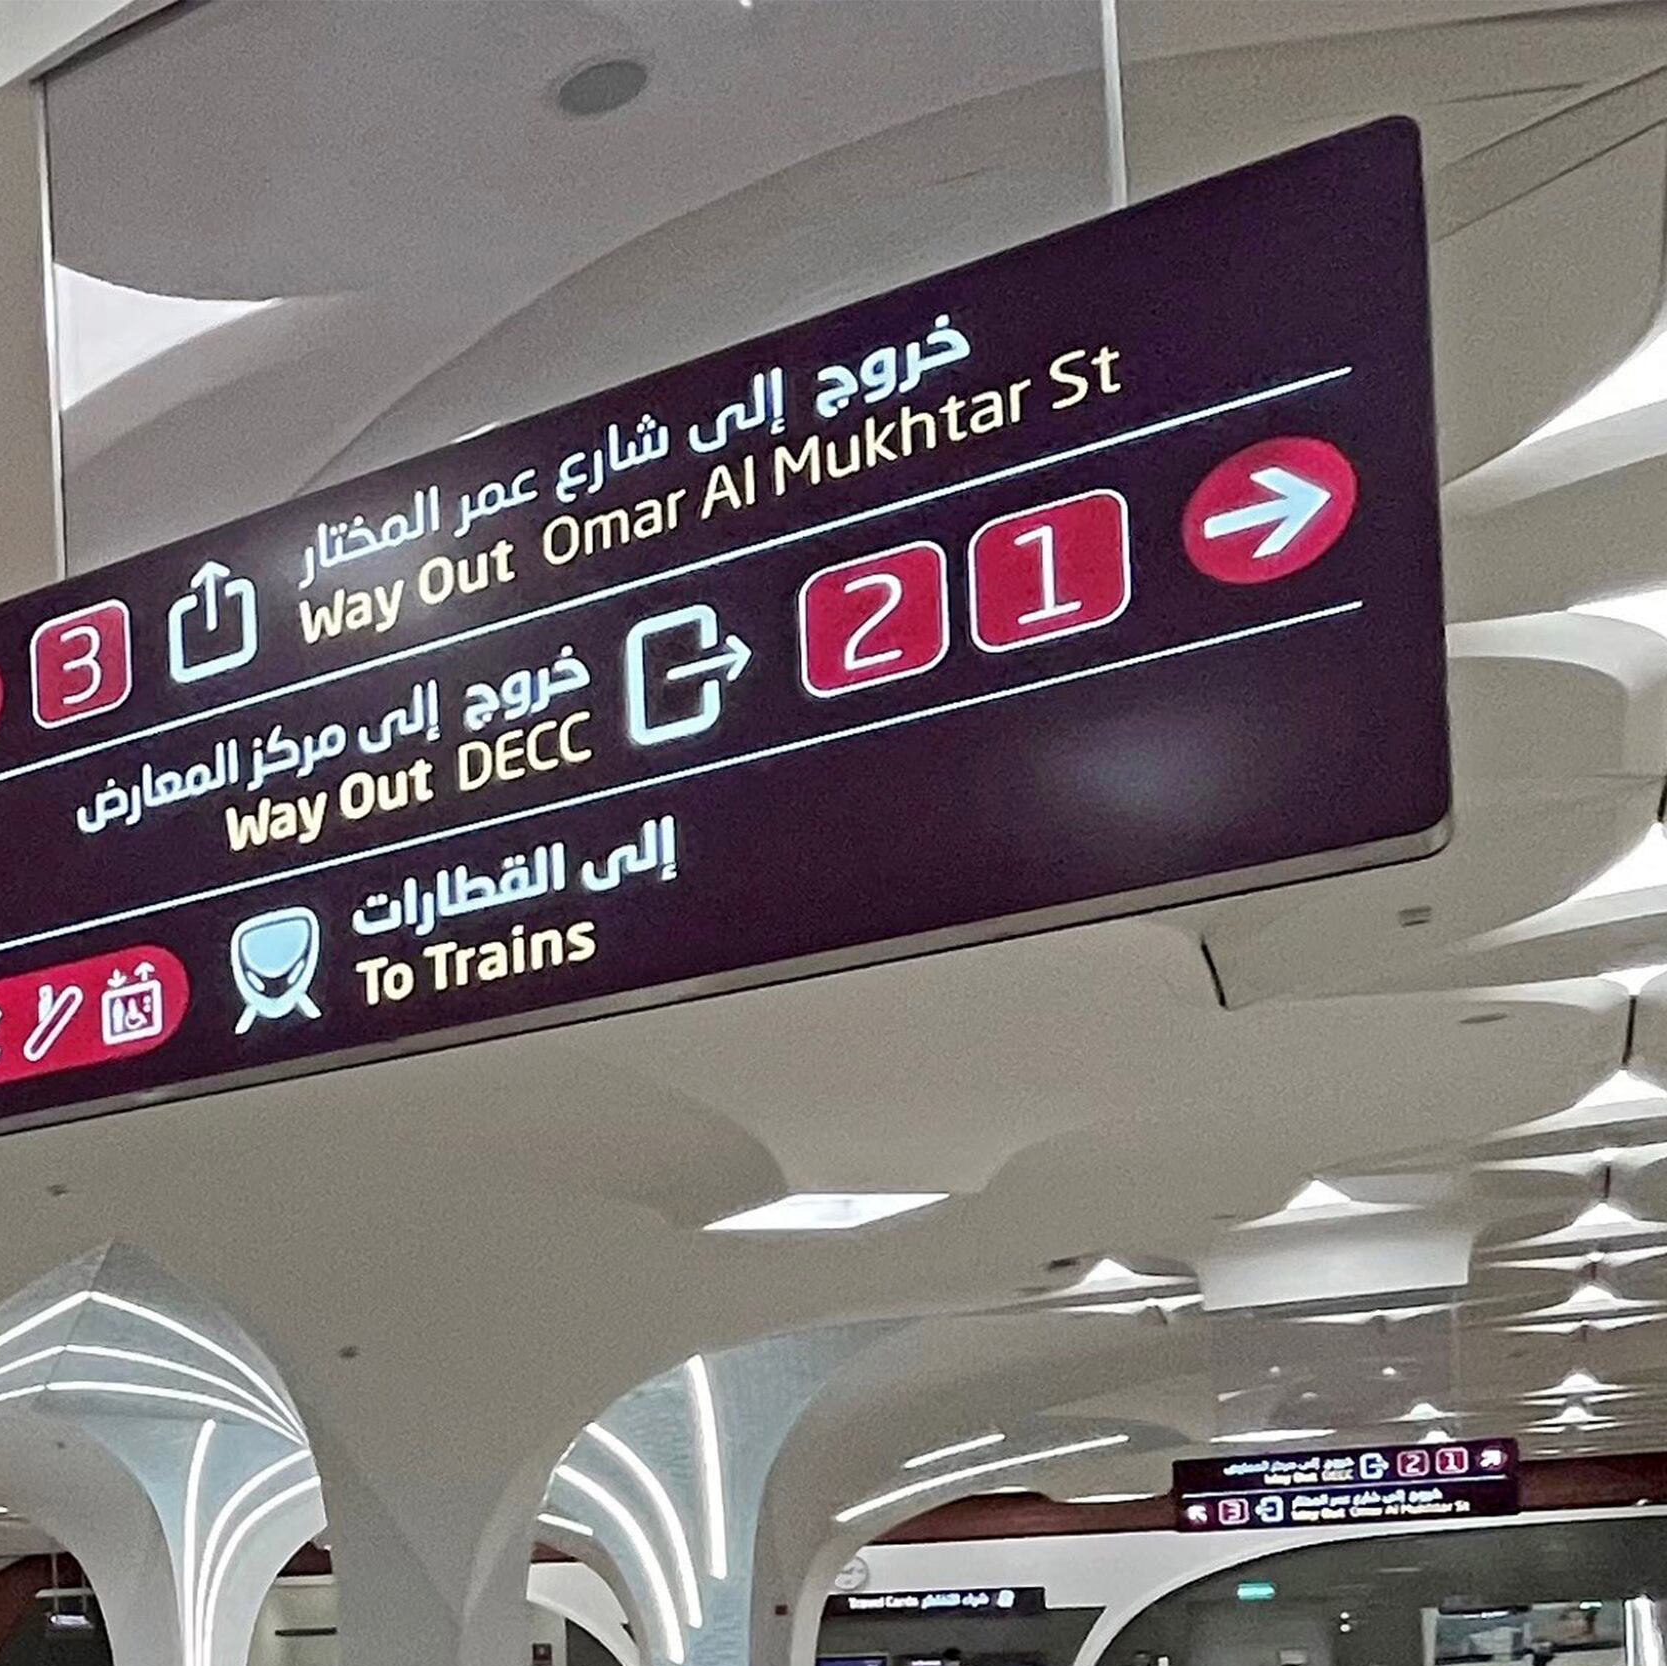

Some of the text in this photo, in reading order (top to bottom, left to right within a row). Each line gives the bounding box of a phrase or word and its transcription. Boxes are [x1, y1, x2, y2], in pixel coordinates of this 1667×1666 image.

[297, 314, 971, 592] خروج إلى شارع عمر المختار
[298, 346, 1121, 644] Way Out Omar Al Mukhtar St
[60, 625, 102, 705] 3
[843, 525, 1082, 671] 2 1
[76, 645, 591, 833] خروج إلى مركز المعارض
[225, 711, 592, 852] Way Out DECC
[352, 815, 677, 937] إلى القطارات
[355, 921, 596, 1005] To Trains
[1405, 1452, 1459, 1473] 2 1
